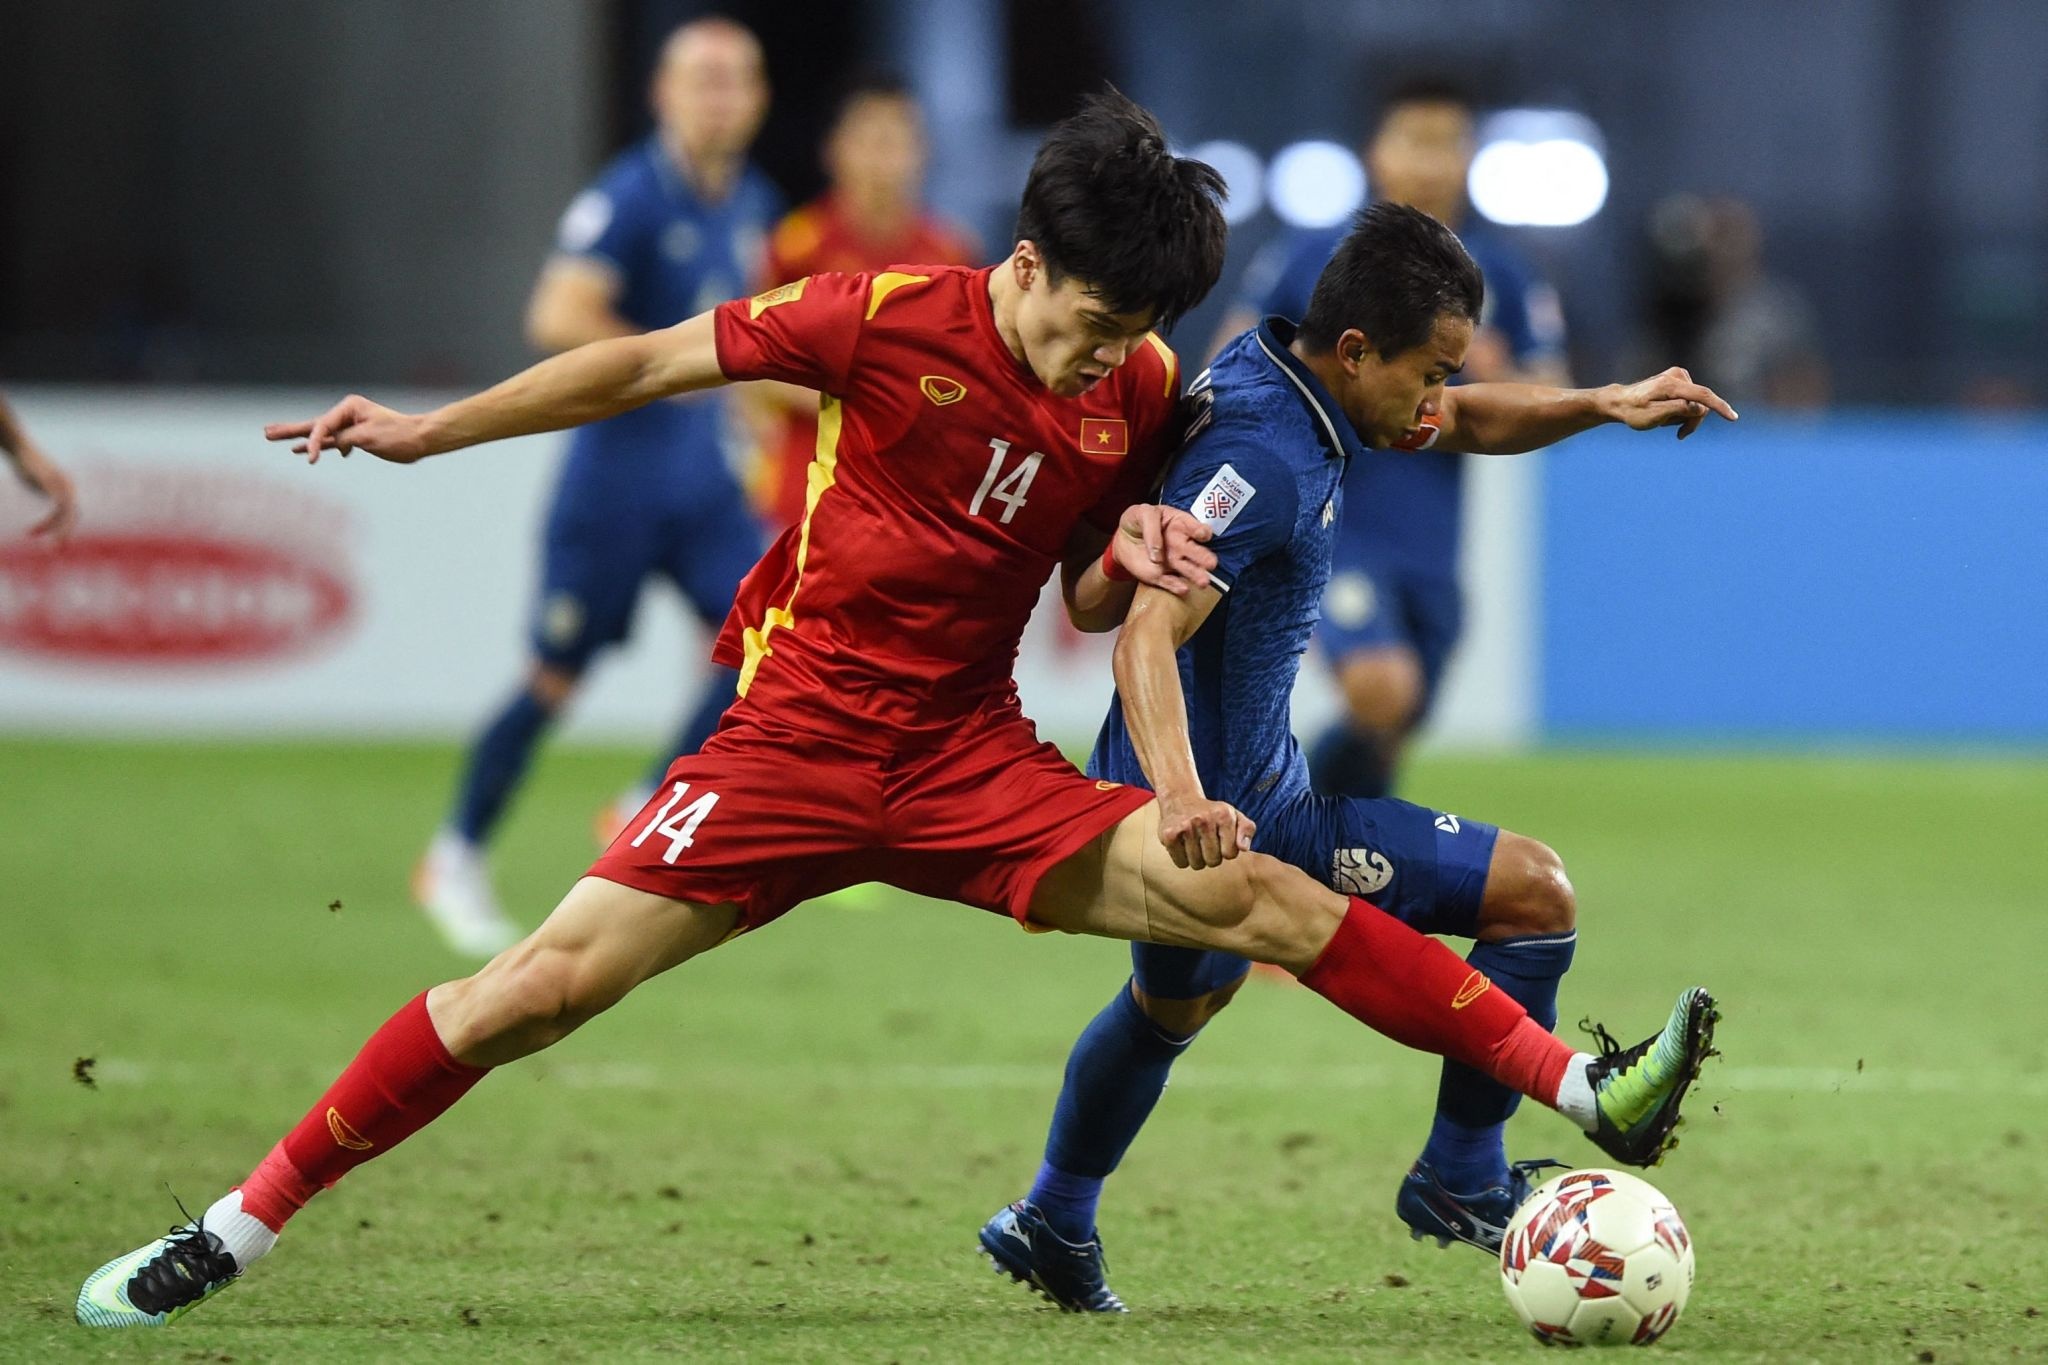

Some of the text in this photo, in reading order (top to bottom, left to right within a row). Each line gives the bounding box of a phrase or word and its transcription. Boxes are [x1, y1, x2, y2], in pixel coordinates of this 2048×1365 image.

[968, 438, 1045, 524] 14
[1222, 475, 1245, 497] SUZUKI
[630, 781, 721, 865] 14
